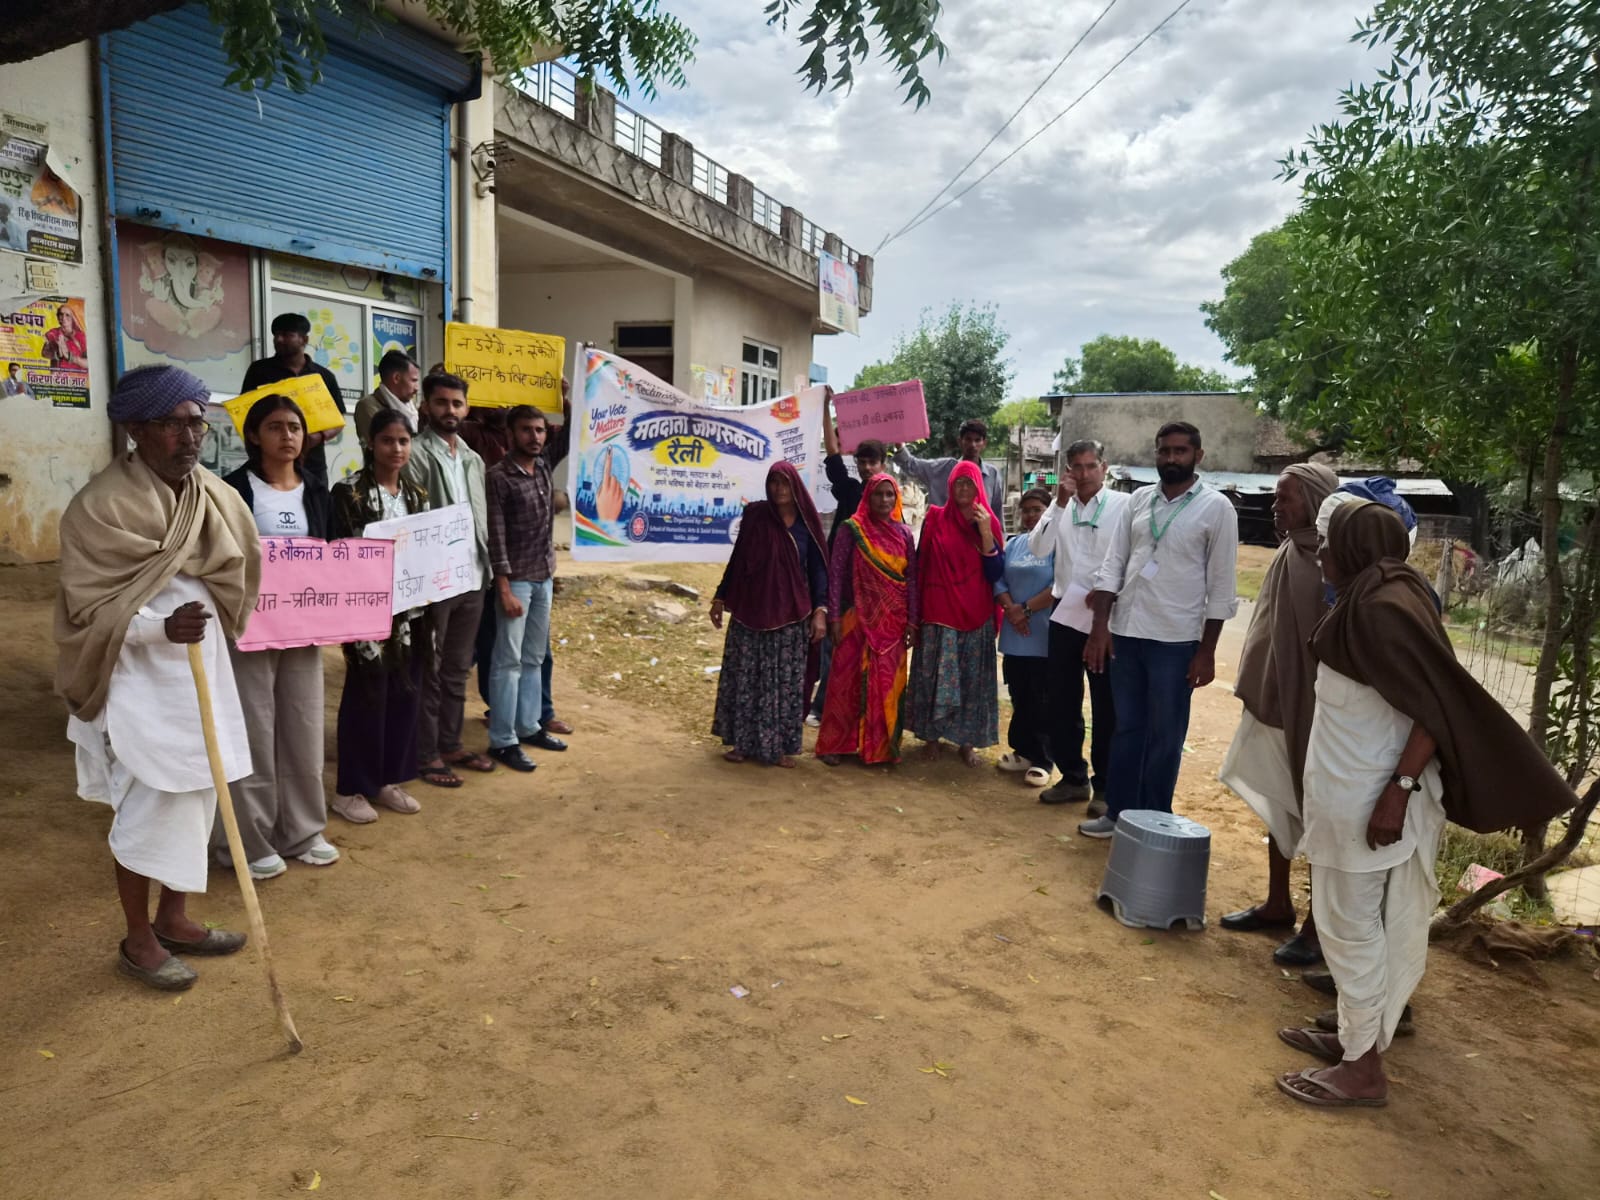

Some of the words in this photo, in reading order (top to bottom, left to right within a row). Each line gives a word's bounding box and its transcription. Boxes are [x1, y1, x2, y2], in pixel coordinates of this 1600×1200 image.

[457, 337, 472, 350] न
[514, 345, 525, 357] न
[589, 407, 609, 430] Your
[609, 404, 627, 416] Vote
[594, 417, 625, 437] Matters
[634, 415, 689, 440] मतदाता
[667, 438, 704, 465] रैली
[332, 543, 350, 561] की
[357, 546, 386, 560] शान
